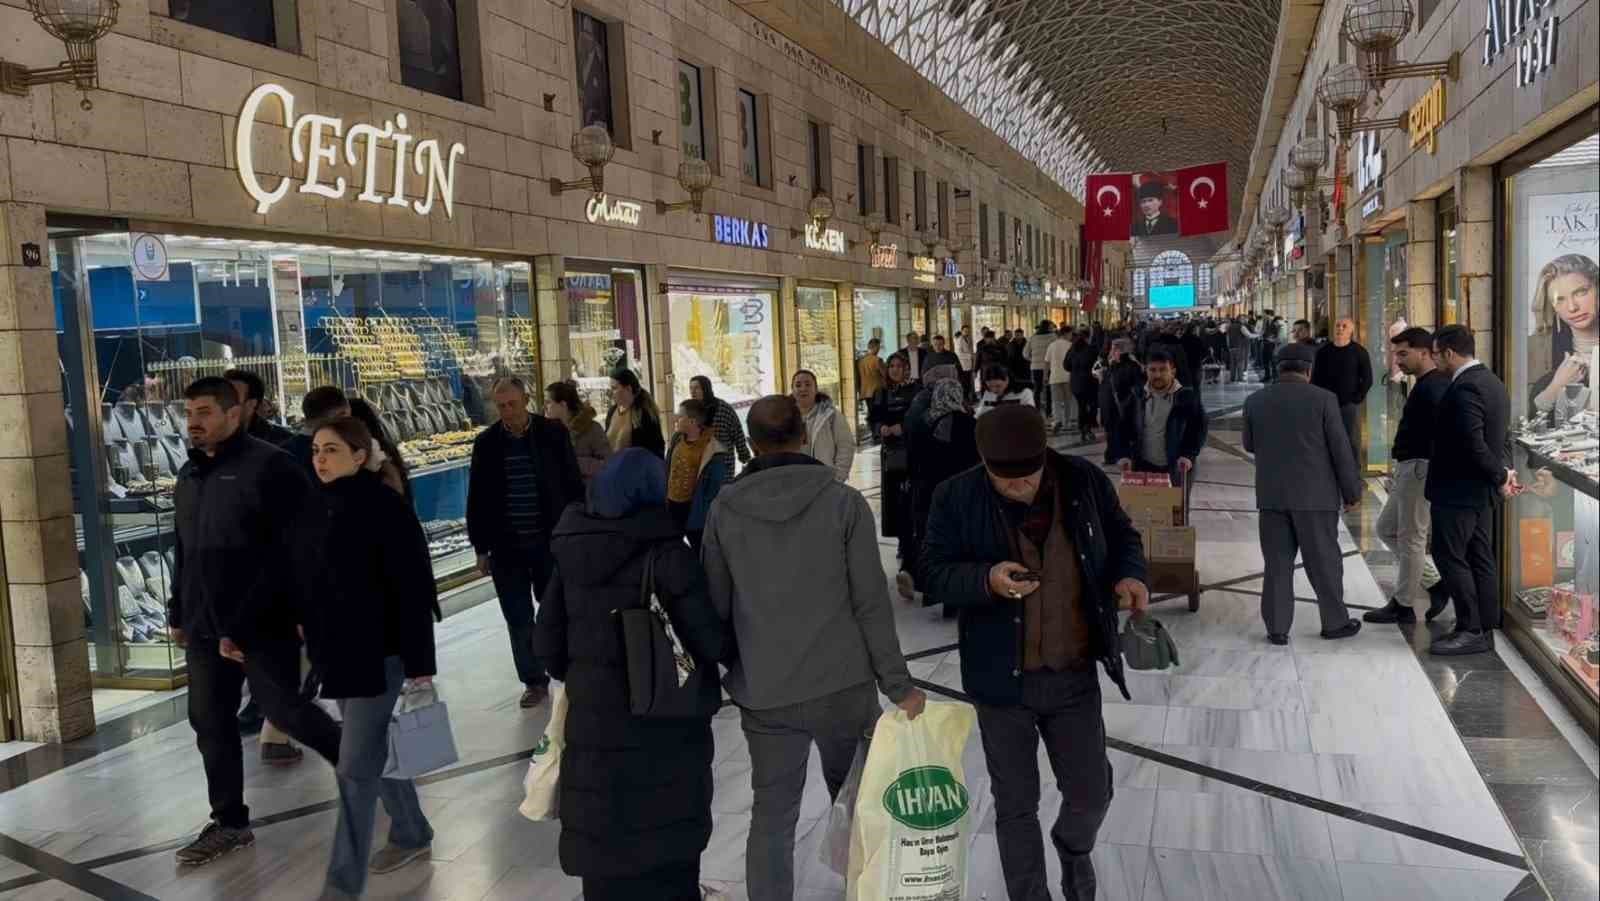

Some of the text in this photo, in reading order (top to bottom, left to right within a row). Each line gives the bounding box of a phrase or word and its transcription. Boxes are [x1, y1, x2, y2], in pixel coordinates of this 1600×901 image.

[1516, 17, 1553, 88] 1937
[235, 83, 465, 219] ÇETİN
[713, 214, 768, 249] BERKAS
[896, 781, 962, 816] İHVAN
